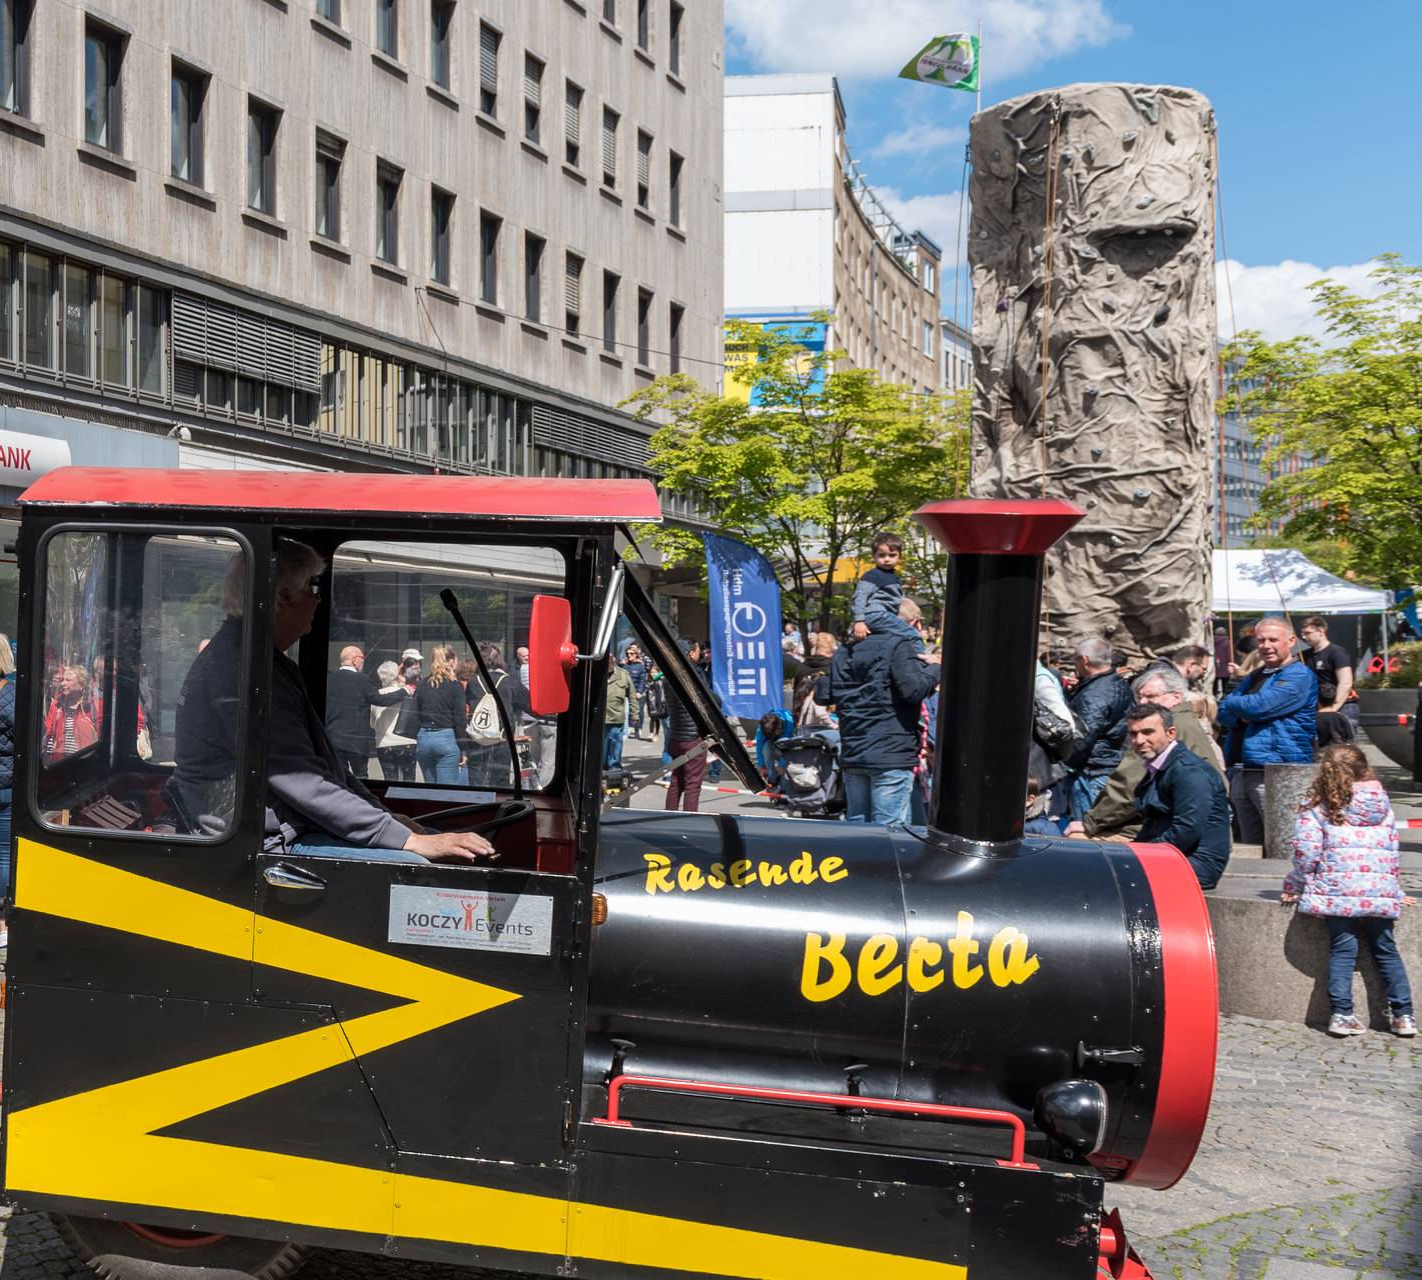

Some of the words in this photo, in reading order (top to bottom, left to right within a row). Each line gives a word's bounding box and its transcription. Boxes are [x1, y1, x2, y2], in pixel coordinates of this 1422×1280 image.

[643, 851, 849, 896] Rasende
[407, 912, 463, 930] KOCZY
[475, 918, 534, 936] Events
